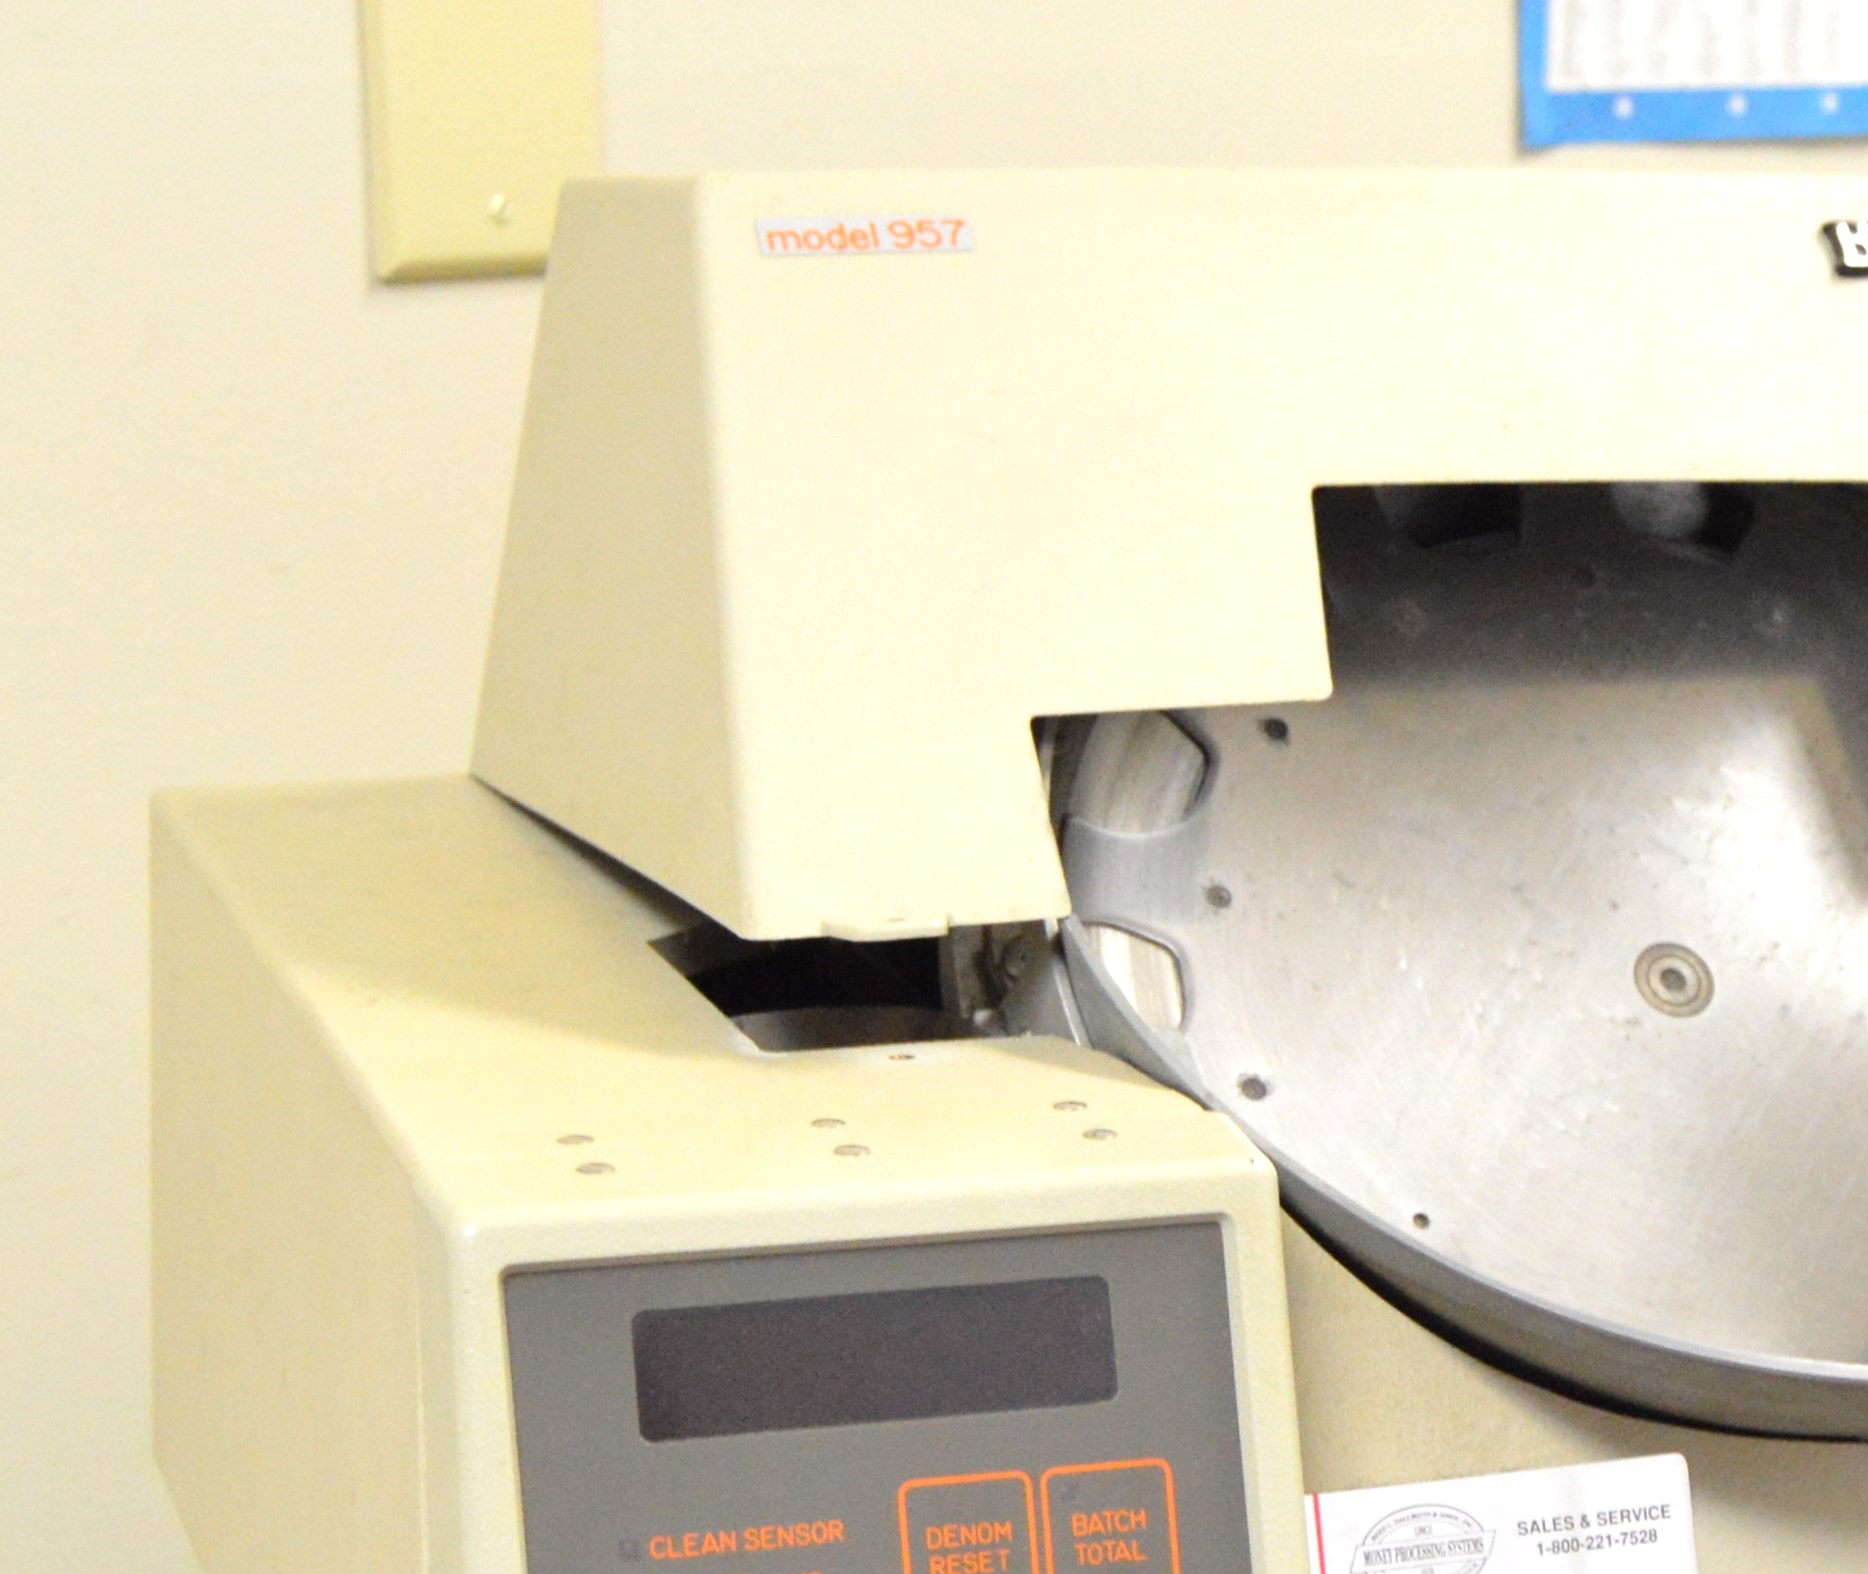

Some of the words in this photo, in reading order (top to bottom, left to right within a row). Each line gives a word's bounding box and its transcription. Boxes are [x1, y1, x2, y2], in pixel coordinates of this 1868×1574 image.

[766, 222, 880, 252] model
[887, 218, 966, 249] 957
[1072, 1509, 1147, 1536] BATCH
[1517, 1517, 1575, 1537] SALES
[1580, 1514, 1592, 1530] &
[1596, 1503, 1673, 1528] SERVICE
[649, 1530, 739, 1560] CLEAN
[744, 1520, 845, 1551] SENSOR
[926, 1521, 1013, 1550] DENOM
[1536, 1528, 1659, 1557] 1-800-221-7528
[1075, 1541, 1148, 1566] TOTAL
[1363, 1547, 1393, 1567] MONEY
[1394, 1541, 1446, 1564] PROCESSING
[1448, 1536, 1485, 1557] SYSTEMS
